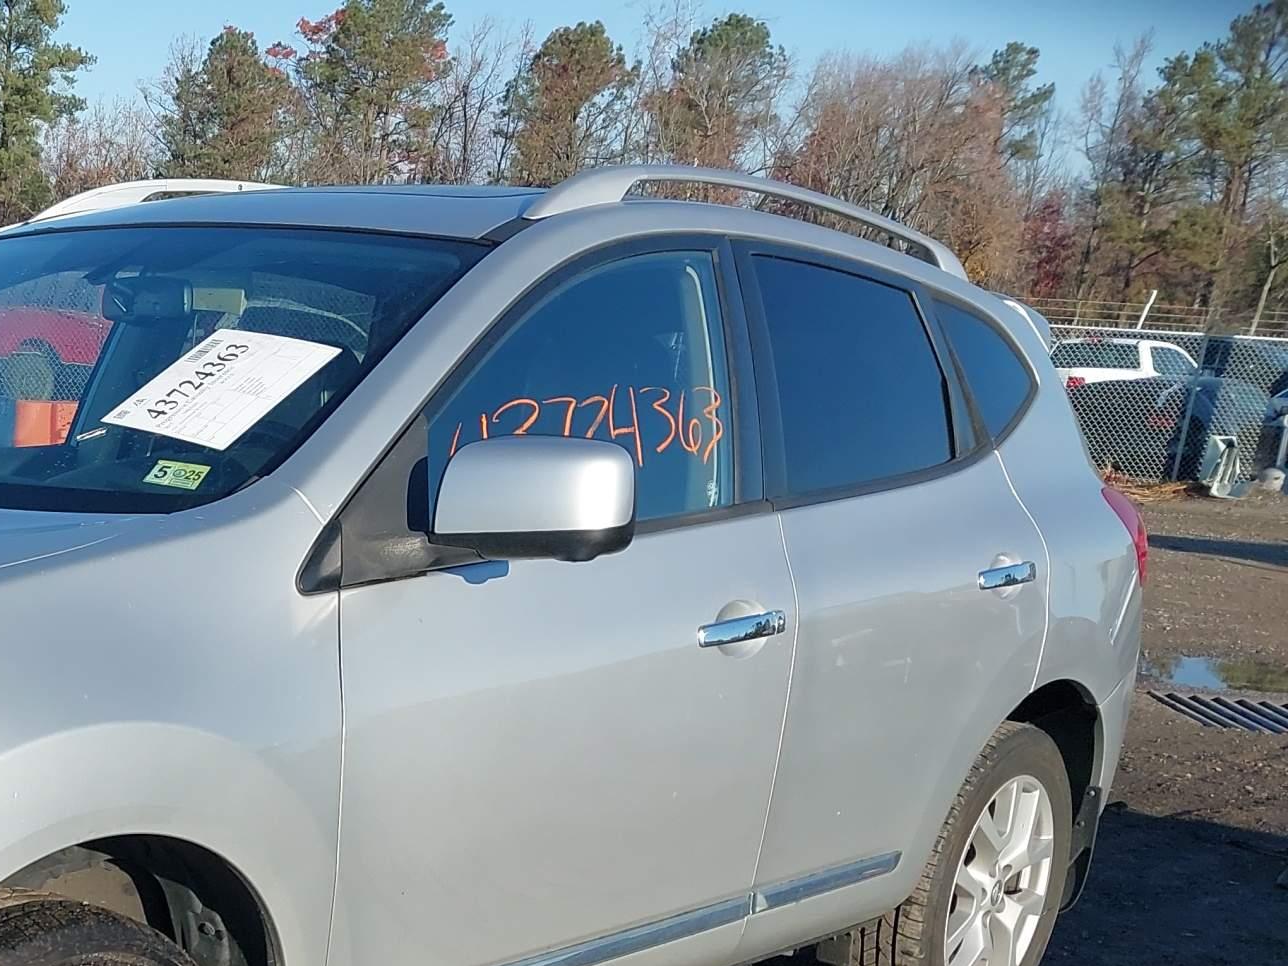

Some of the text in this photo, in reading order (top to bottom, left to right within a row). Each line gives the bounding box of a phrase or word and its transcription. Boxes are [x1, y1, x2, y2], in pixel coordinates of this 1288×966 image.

[146, 343, 250, 420] 43724363
[153, 465, 172, 479] 5
[184, 469, 205, 481] 25
